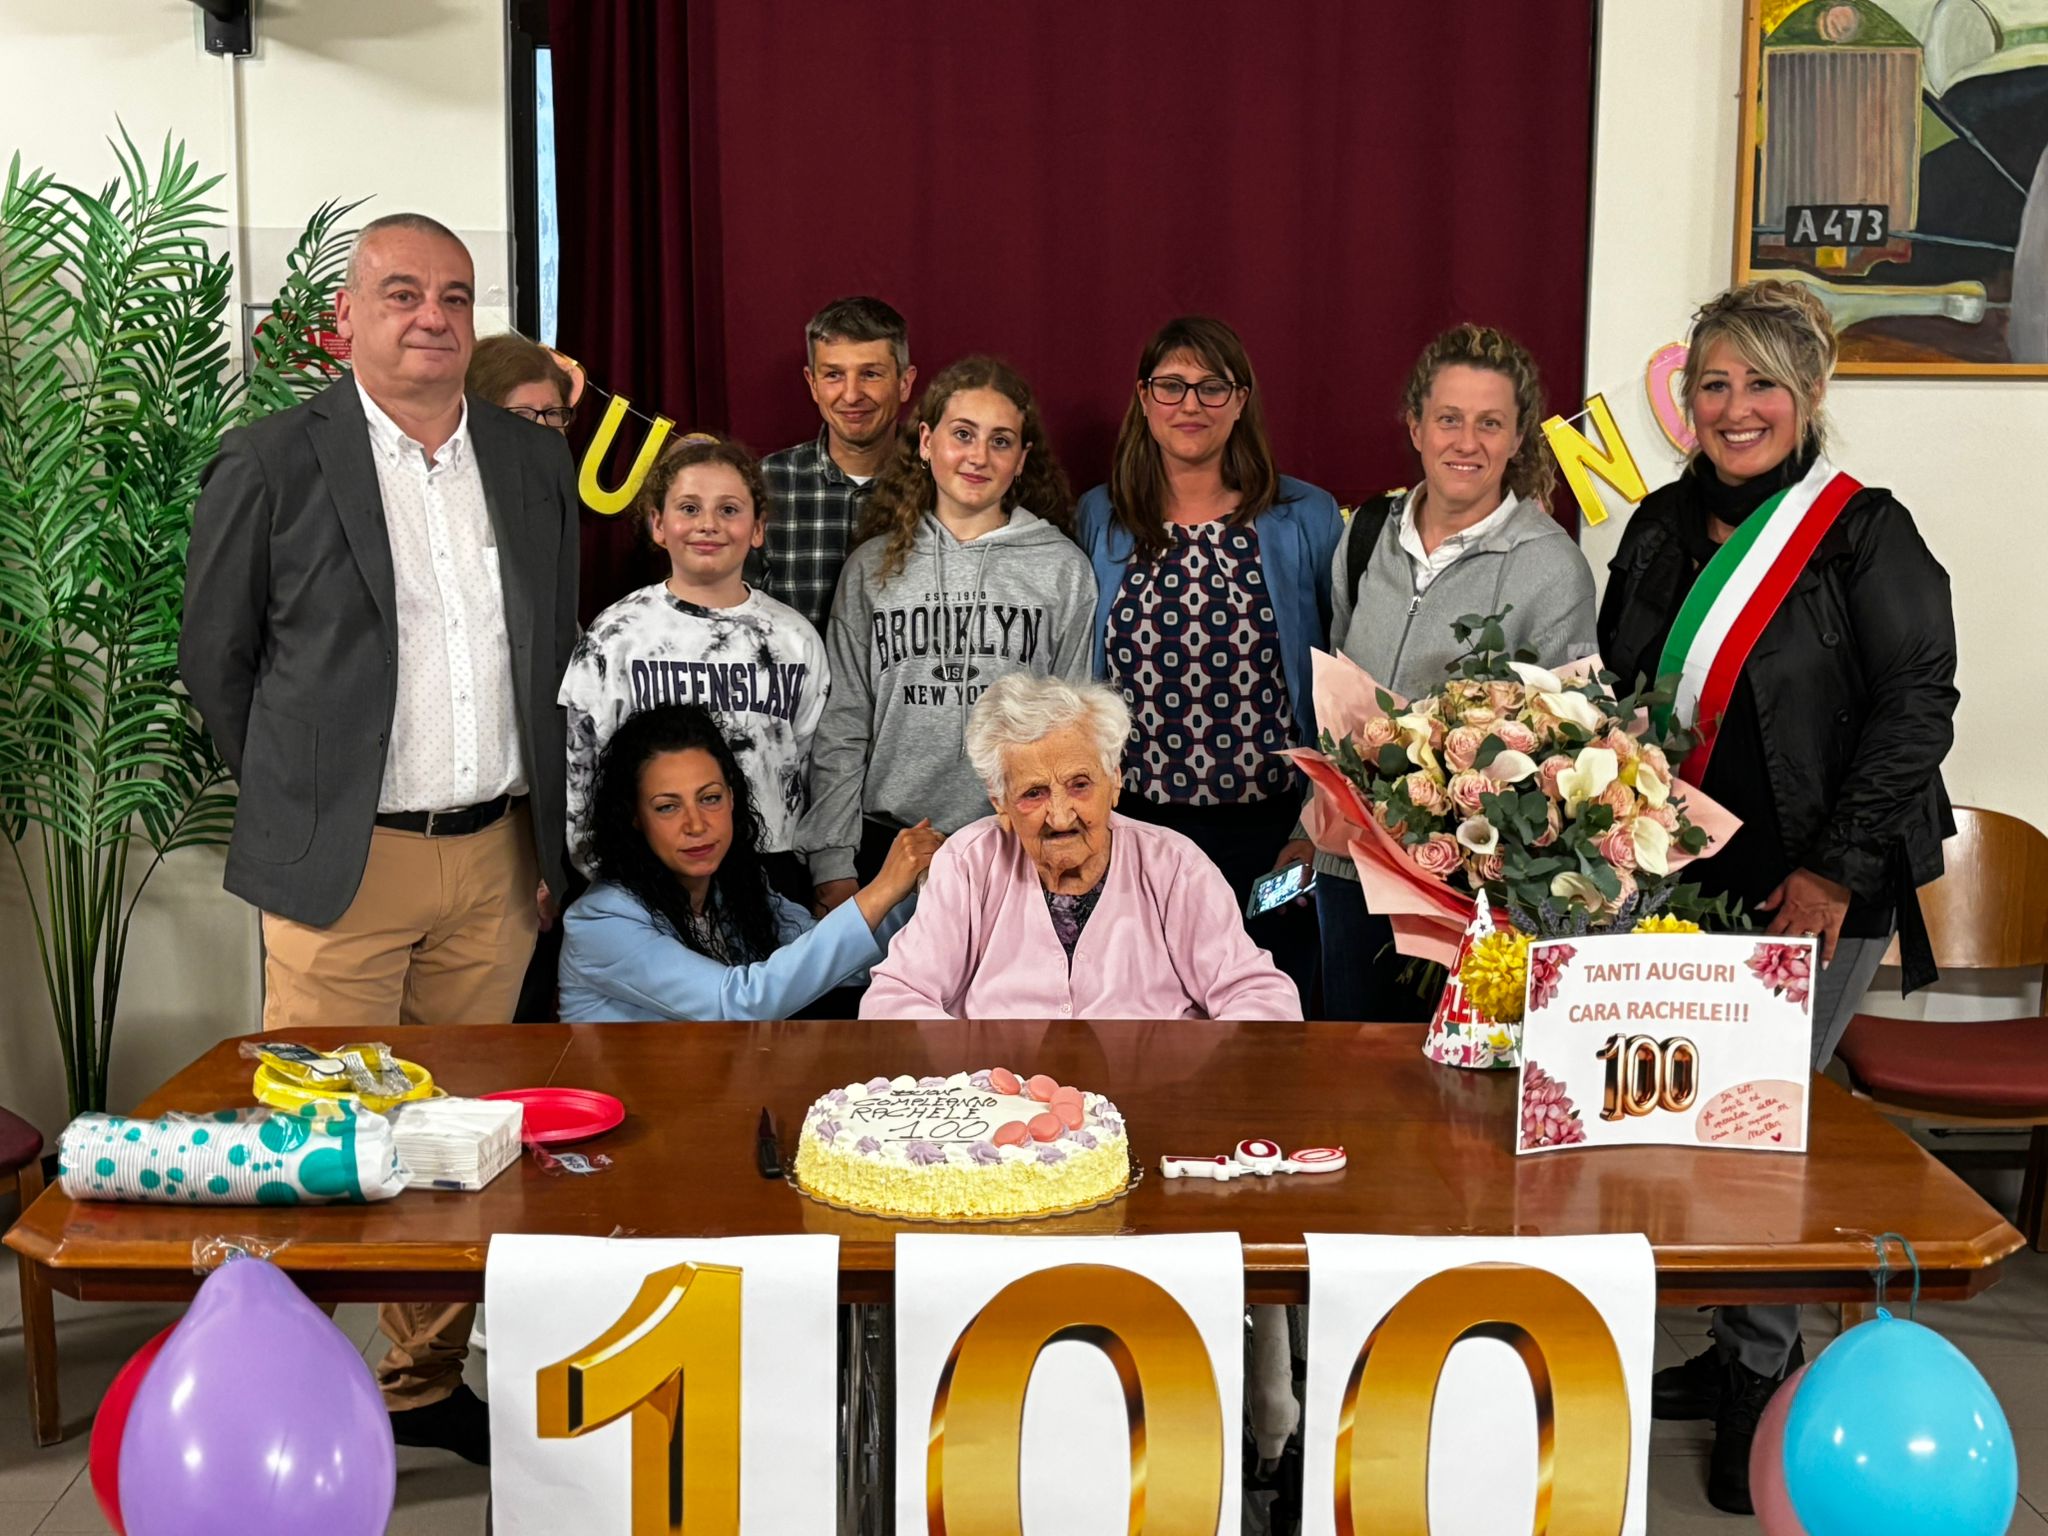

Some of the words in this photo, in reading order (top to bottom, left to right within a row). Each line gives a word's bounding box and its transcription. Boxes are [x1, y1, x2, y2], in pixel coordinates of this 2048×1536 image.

[872, 602, 1044, 673] BROOKLYN
[631, 659, 806, 724] QUEENSLAN
[903, 684, 948, 706] NEW
[954, 684, 990, 706] YO
[1583, 962, 1640, 983] TANTI
[1646, 962, 1736, 983] AUGURI
[1568, 1001, 1622, 1023] CARA
[1627, 1001, 1749, 1023] RACHELE!!!
[1595, 1032, 1700, 1122] 100
[852, 1096, 998, 1109] COMPLEANNO
[850, 1106, 981, 1123] RACHELE
[888, 1120, 990, 1140] 100
